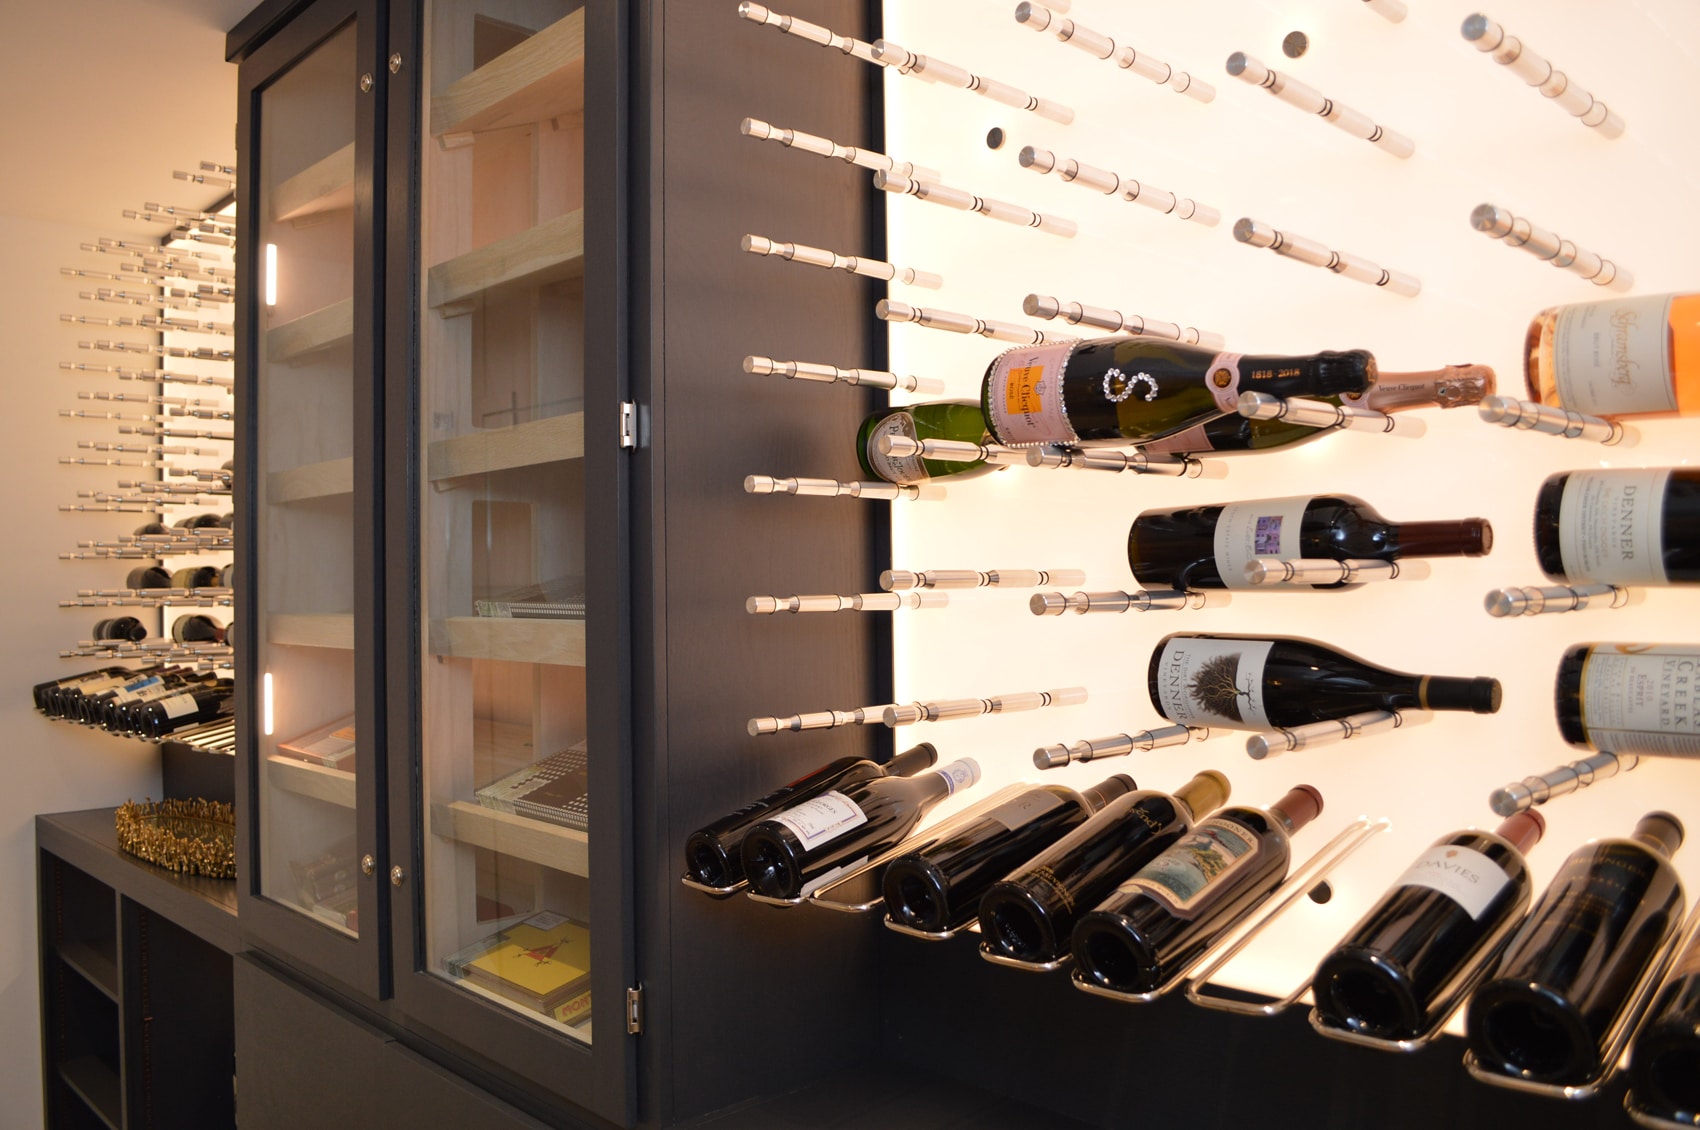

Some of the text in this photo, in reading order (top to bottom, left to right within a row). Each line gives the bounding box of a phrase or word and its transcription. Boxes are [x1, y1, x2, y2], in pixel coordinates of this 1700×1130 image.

[1020, 356, 1040, 428] Veuve Clicquot
[1278, 367, 1301, 378] 2018
[1619, 485, 1637, 561] DENNER
[1169, 650, 1188, 720] DENNER
[1659, 659, 1676, 726] VINEYARD
[1674, 660, 1694, 727] CREEK
